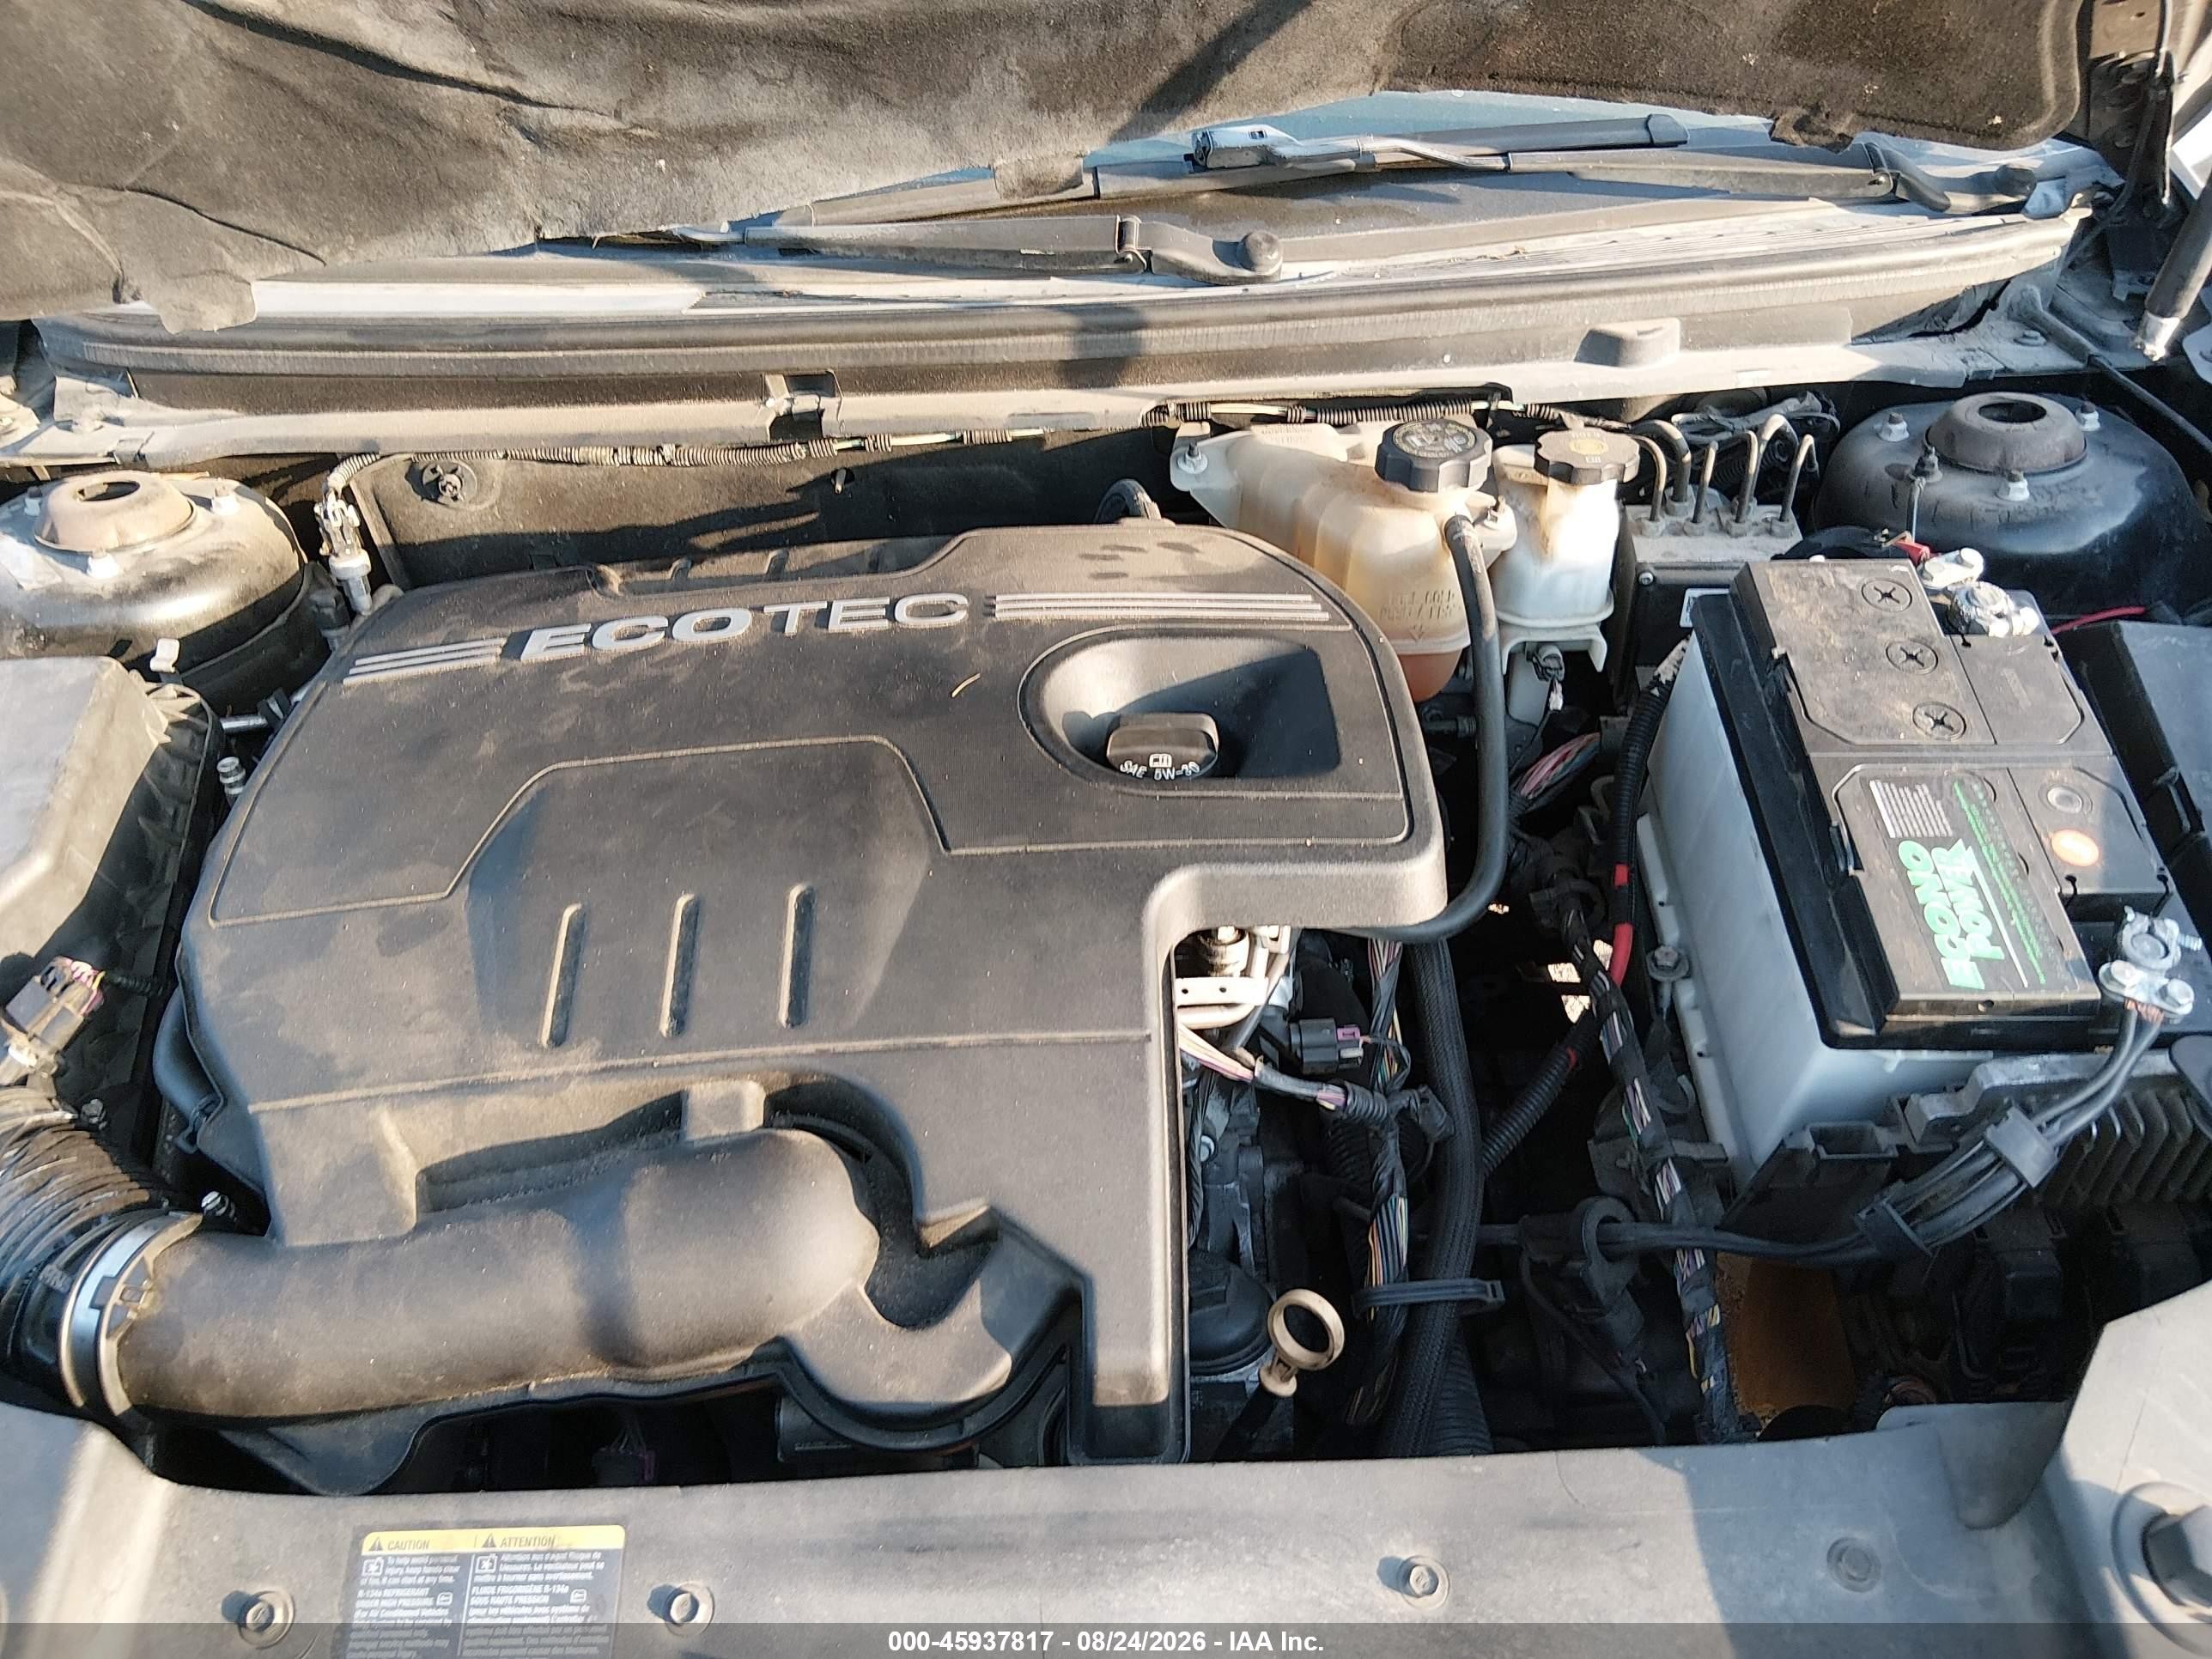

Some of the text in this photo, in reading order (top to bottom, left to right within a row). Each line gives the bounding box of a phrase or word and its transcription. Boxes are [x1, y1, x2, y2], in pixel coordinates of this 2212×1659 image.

[520, 592, 969, 662] ECOTEC
[1120, 760, 1147, 779] SAE
[1898, 840, 1985, 989] ECONO
[1931, 839, 2005, 960] POWER
[387, 1539, 430, 1551] CAUTION
[500, 1534, 556, 1547] ATTENTION
